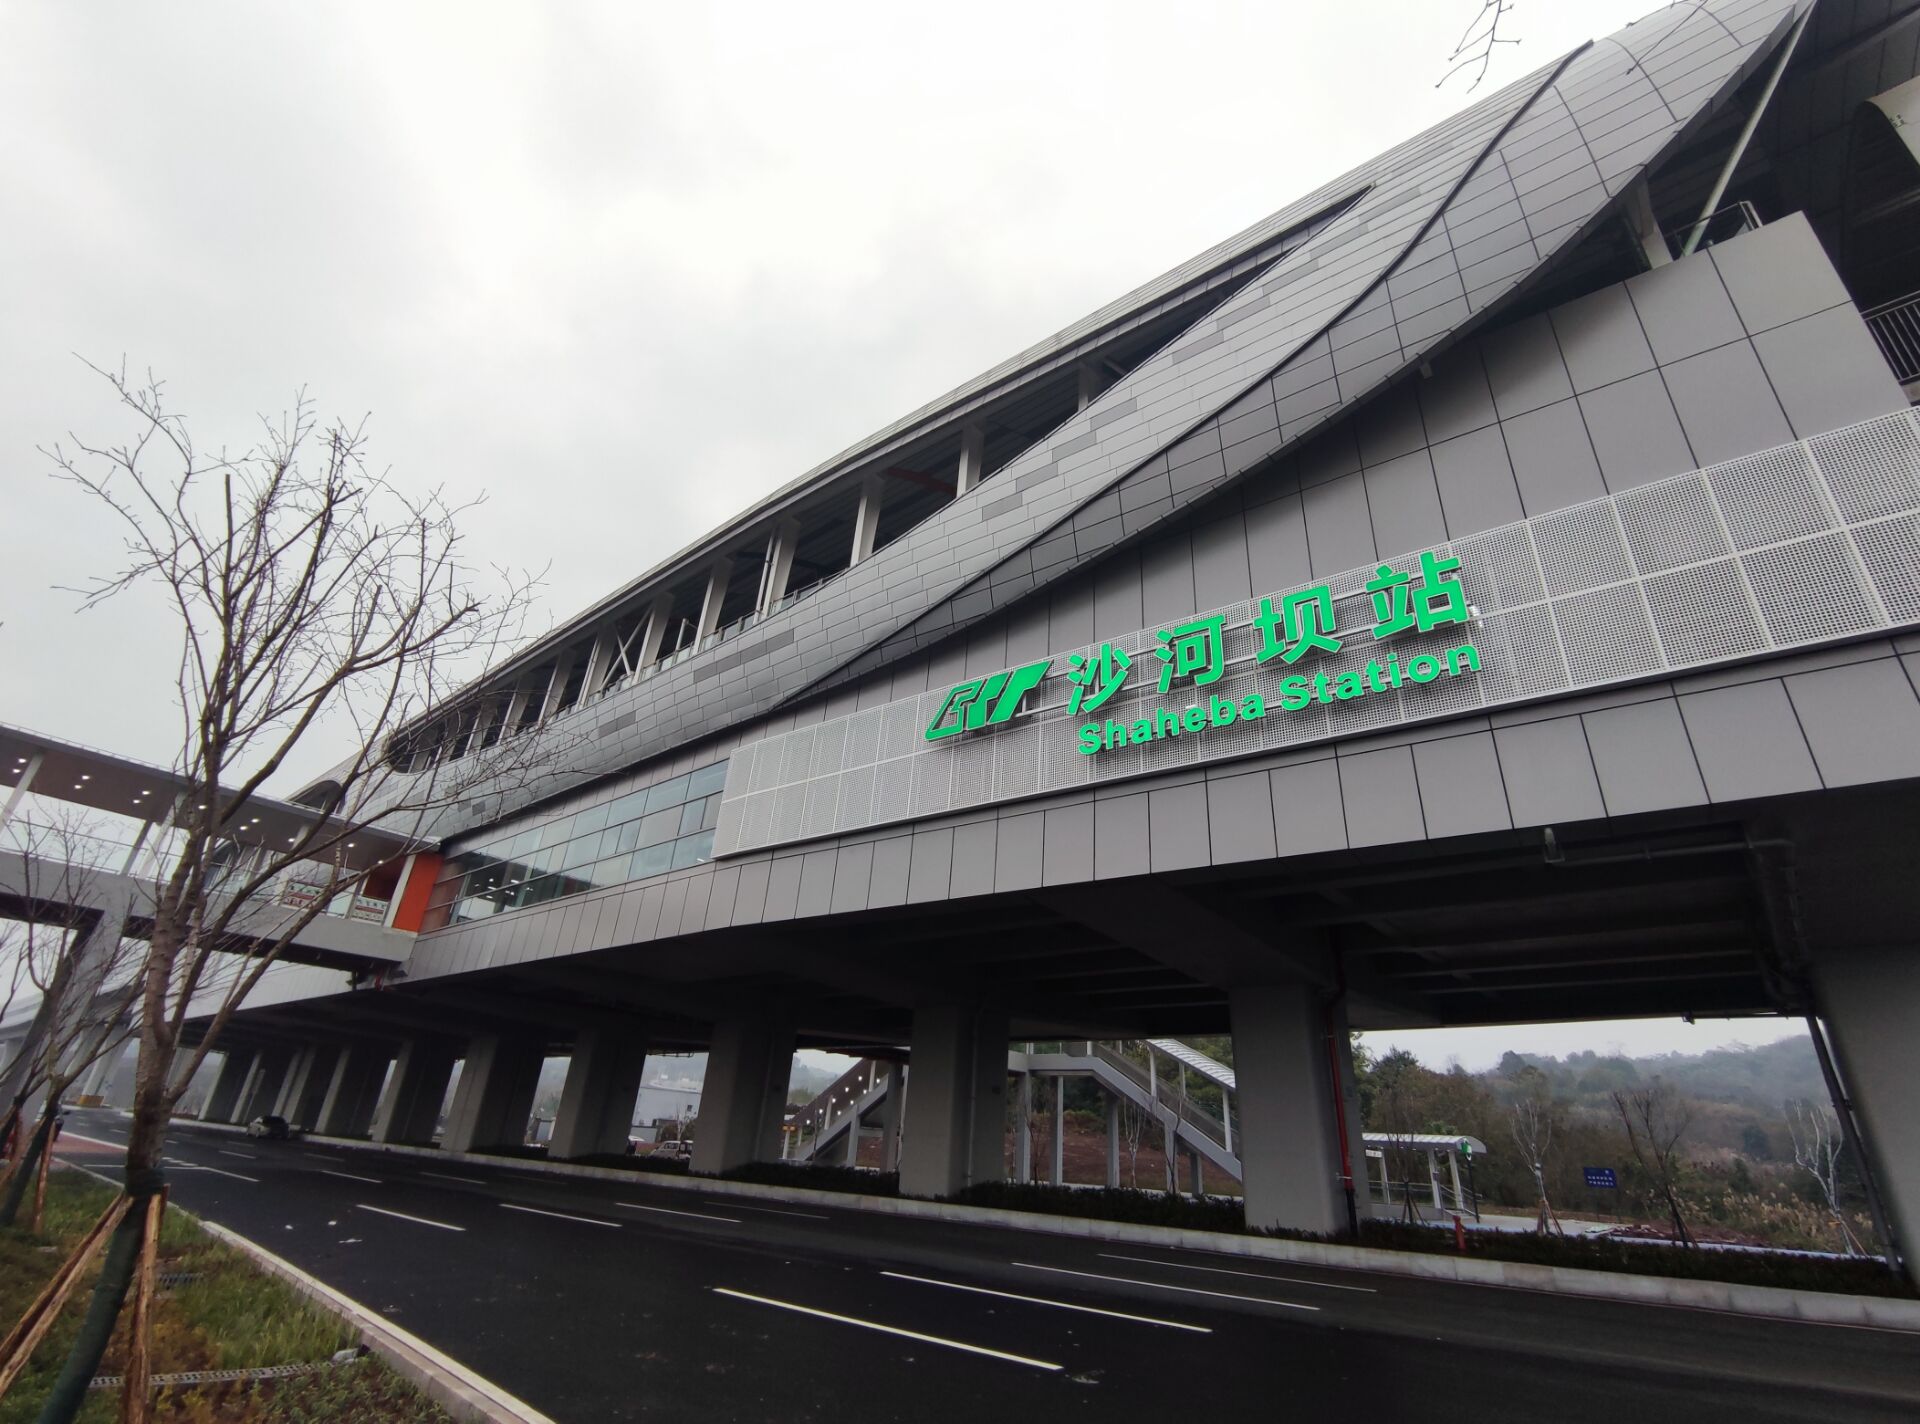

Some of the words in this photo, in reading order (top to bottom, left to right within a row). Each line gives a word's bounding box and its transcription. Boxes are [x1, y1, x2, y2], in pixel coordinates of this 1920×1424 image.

[1067, 551, 1469, 715] 沙河坝站
[1078, 692, 1267, 757] Shaheba
[1278, 643, 1481, 714] Station
